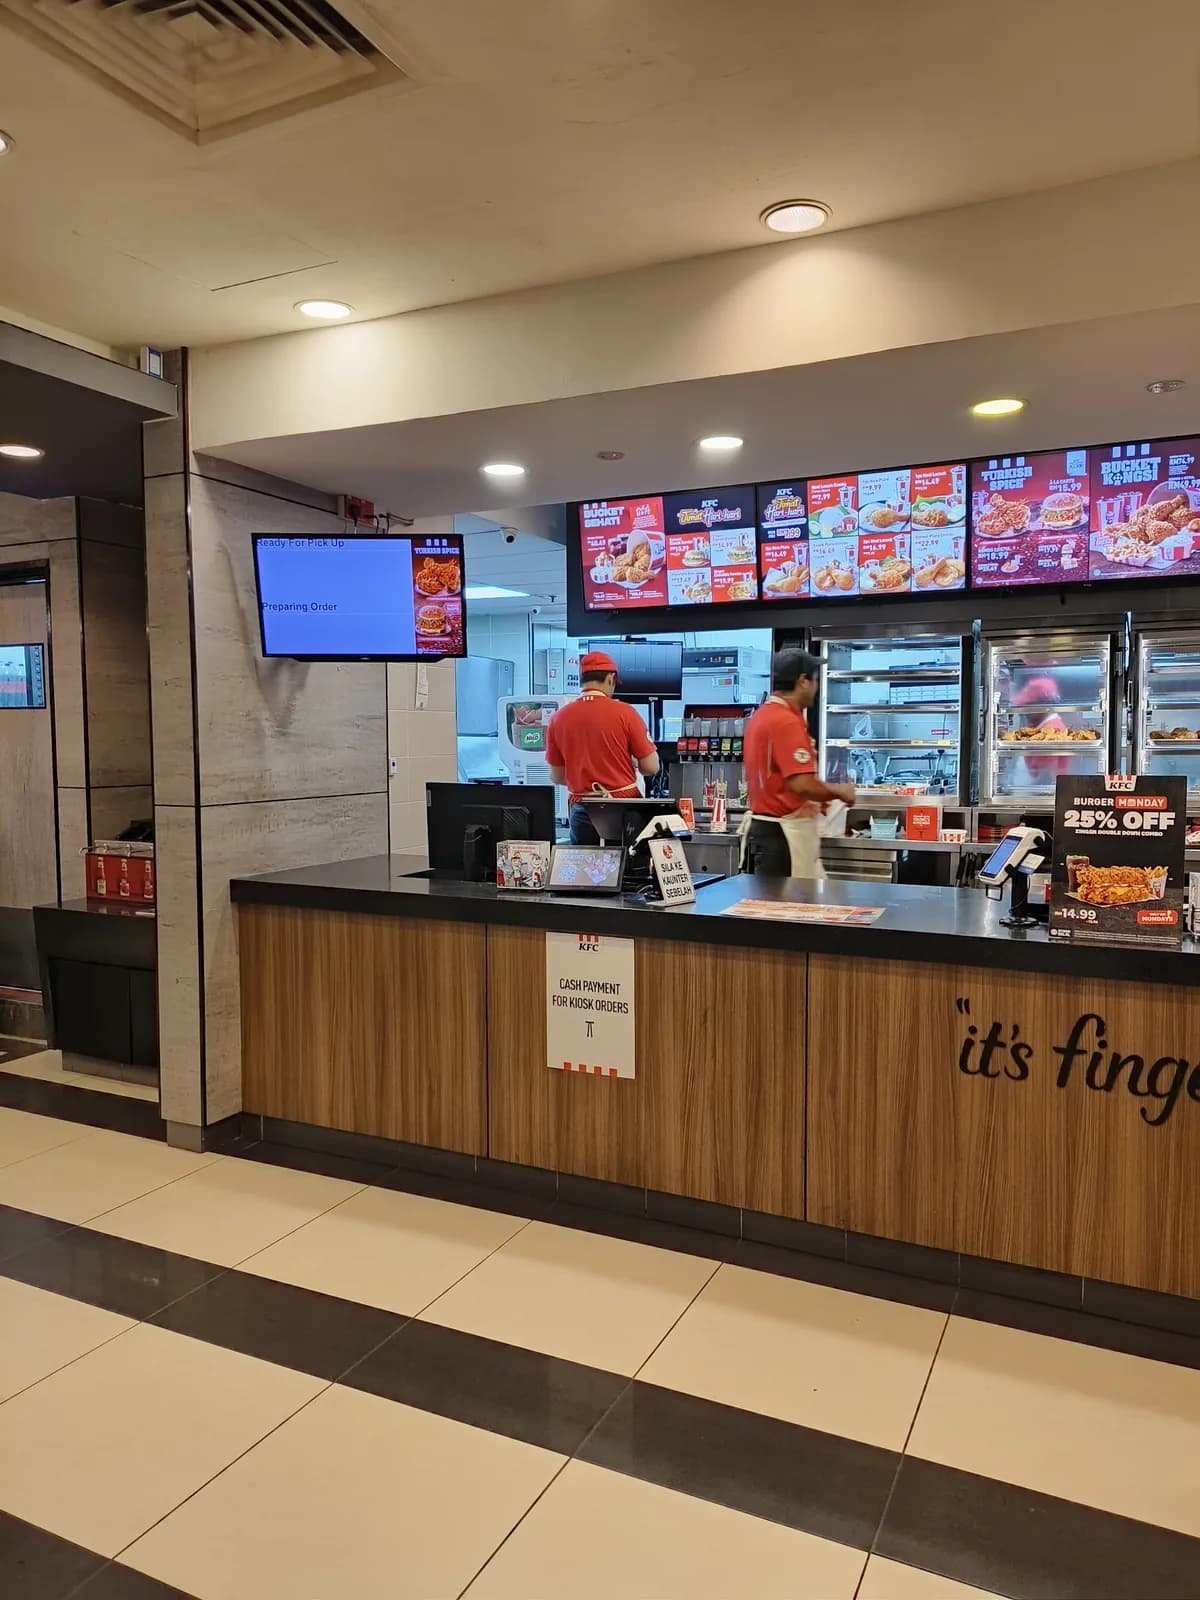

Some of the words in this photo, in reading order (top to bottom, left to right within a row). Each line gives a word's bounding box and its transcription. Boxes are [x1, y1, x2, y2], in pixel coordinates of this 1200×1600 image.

[1101, 457, 1161, 474] BUCKET
[981, 466, 1032, 481] TURKISH
[990, 478, 1025, 490] SPICE
[777, 488, 793, 496] KFC
[702, 499, 718, 508] KFC
[584, 507, 625, 518] BUCKET
[257, 539, 285, 549] Ready
[289, 539, 305, 547] For
[308, 539, 329, 547] Pick
[331, 539, 345, 549] Up
[262, 603, 308, 612] Preparing
[311, 603, 337, 611] Order
[1110, 782, 1132, 790] KFC
[1073, 797, 1114, 806] BURGER
[1064, 809, 1118, 829] 25%
[1122, 811, 1176, 830] OFF
[661, 863, 675, 873] SILA
[674, 861, 683, 870] KE
[662, 873, 689, 885] KAUNTER
[666, 886, 692, 898] SEBELAH
[579, 943, 599, 952] KFC
[560, 978, 582, 991] CASH
[582, 980, 621, 996] PAYMENT
[552, 995, 568, 1008] FOR
[570, 997, 595, 1011] KIOSK
[596, 999, 629, 1014] ORDERS
